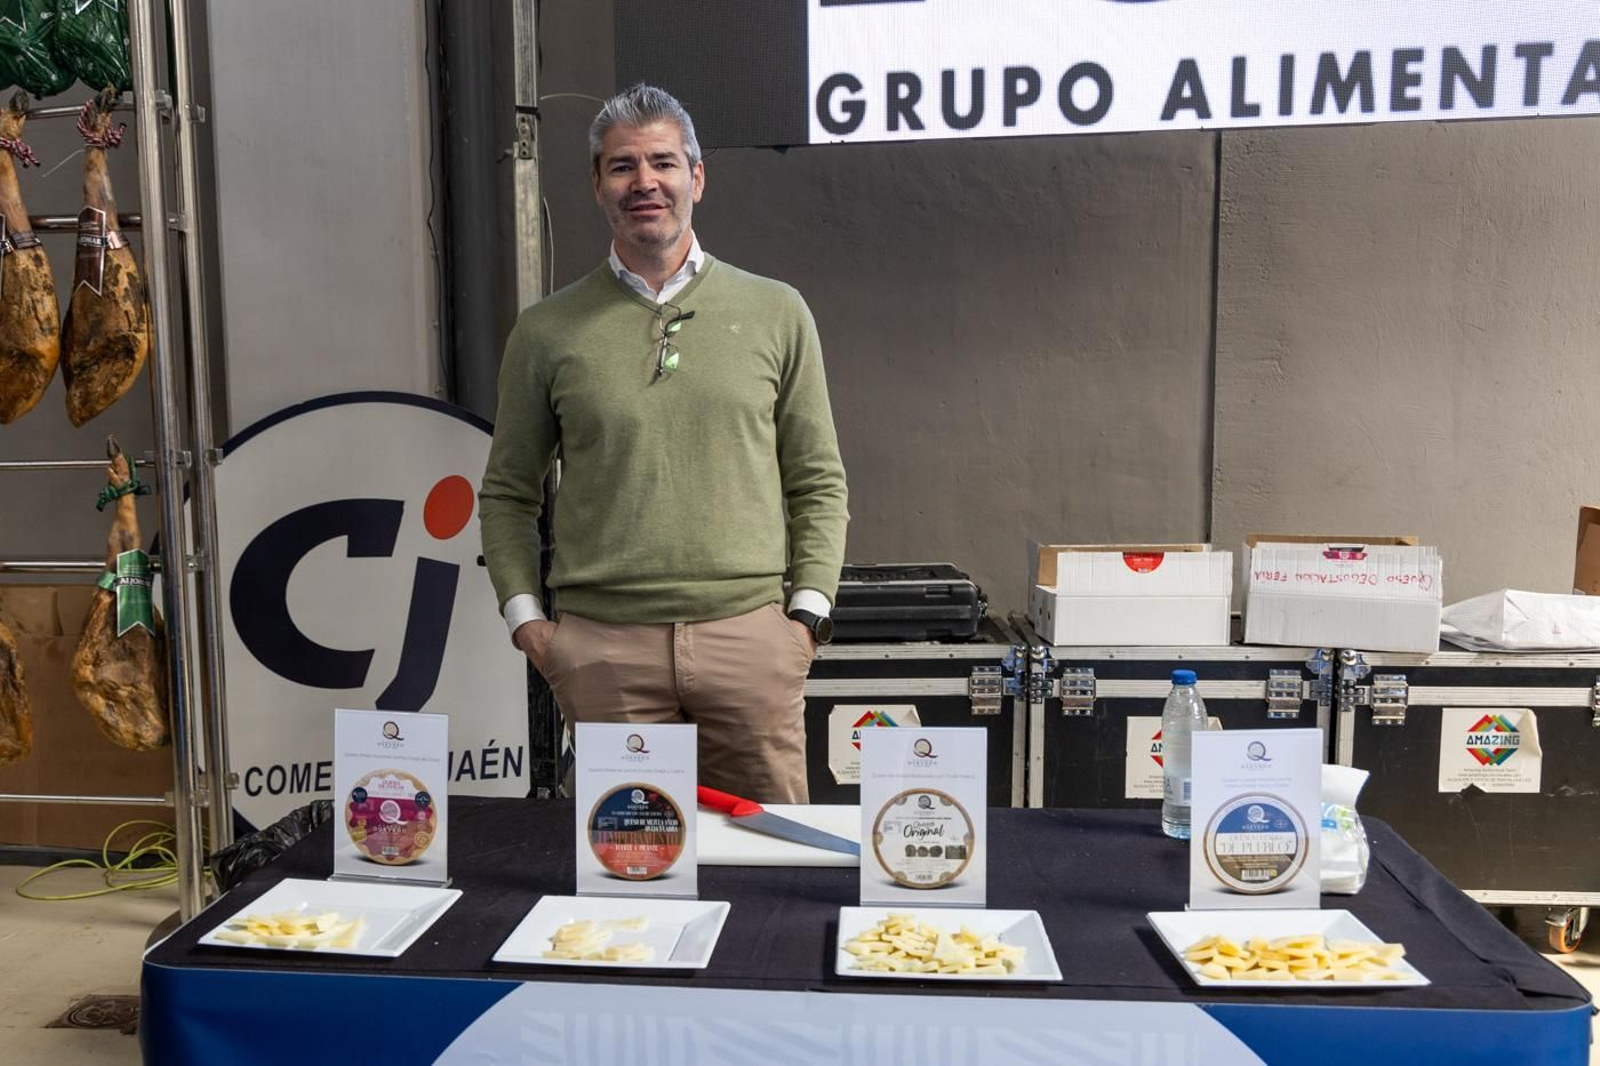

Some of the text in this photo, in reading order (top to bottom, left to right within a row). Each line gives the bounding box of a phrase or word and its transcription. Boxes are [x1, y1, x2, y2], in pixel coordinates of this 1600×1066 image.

[816, 39, 1600, 135] GRUPO ALIMENTA
[1466, 735, 1520, 746] AMAZING
[245, 760, 333, 797] COME
[903, 824, 944, 841] Original
